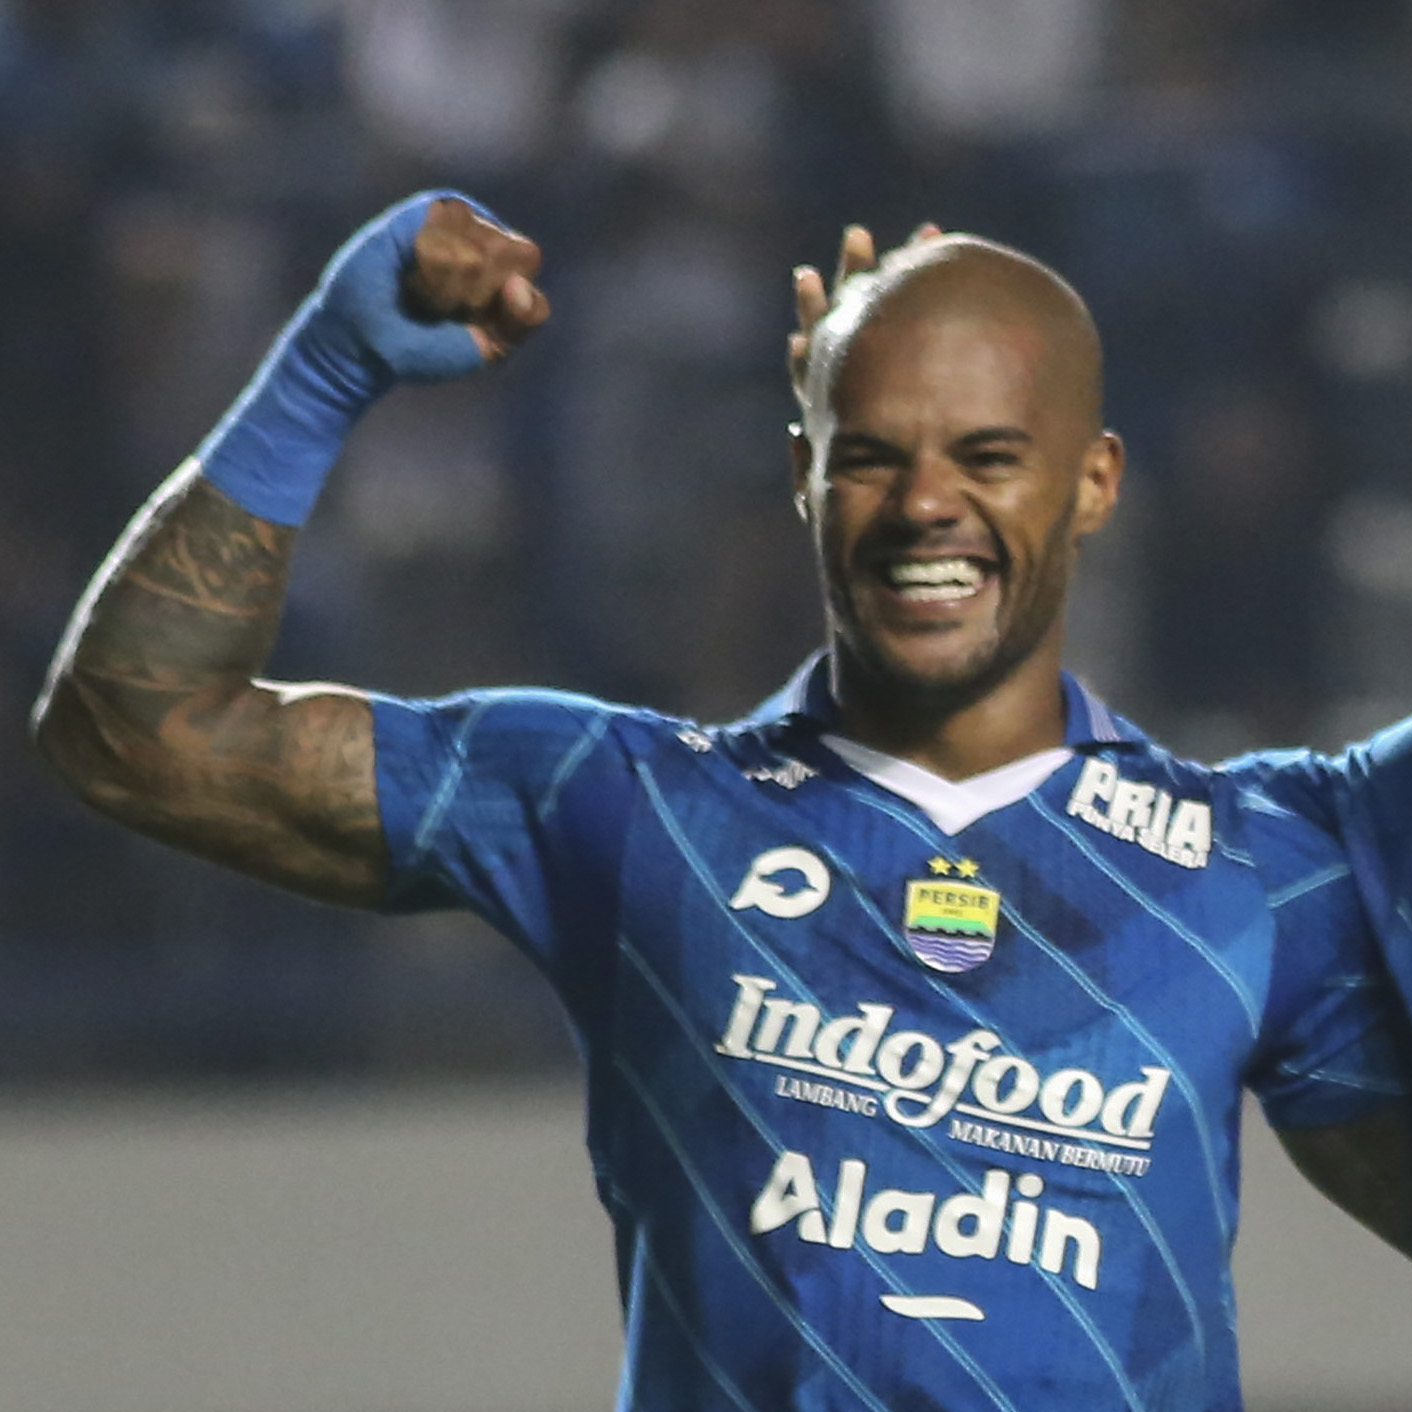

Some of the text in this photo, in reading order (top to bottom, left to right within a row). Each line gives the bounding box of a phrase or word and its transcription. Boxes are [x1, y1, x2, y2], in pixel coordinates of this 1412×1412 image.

[1070, 756, 1212, 853] PRIA
[919, 888, 989, 909] PERSIB
[714, 972, 1172, 1142] Indofood
[775, 1075, 1152, 1178] LAMBANG MAKANAN BERMUTU
[750, 1150, 1102, 1290] Aladin
